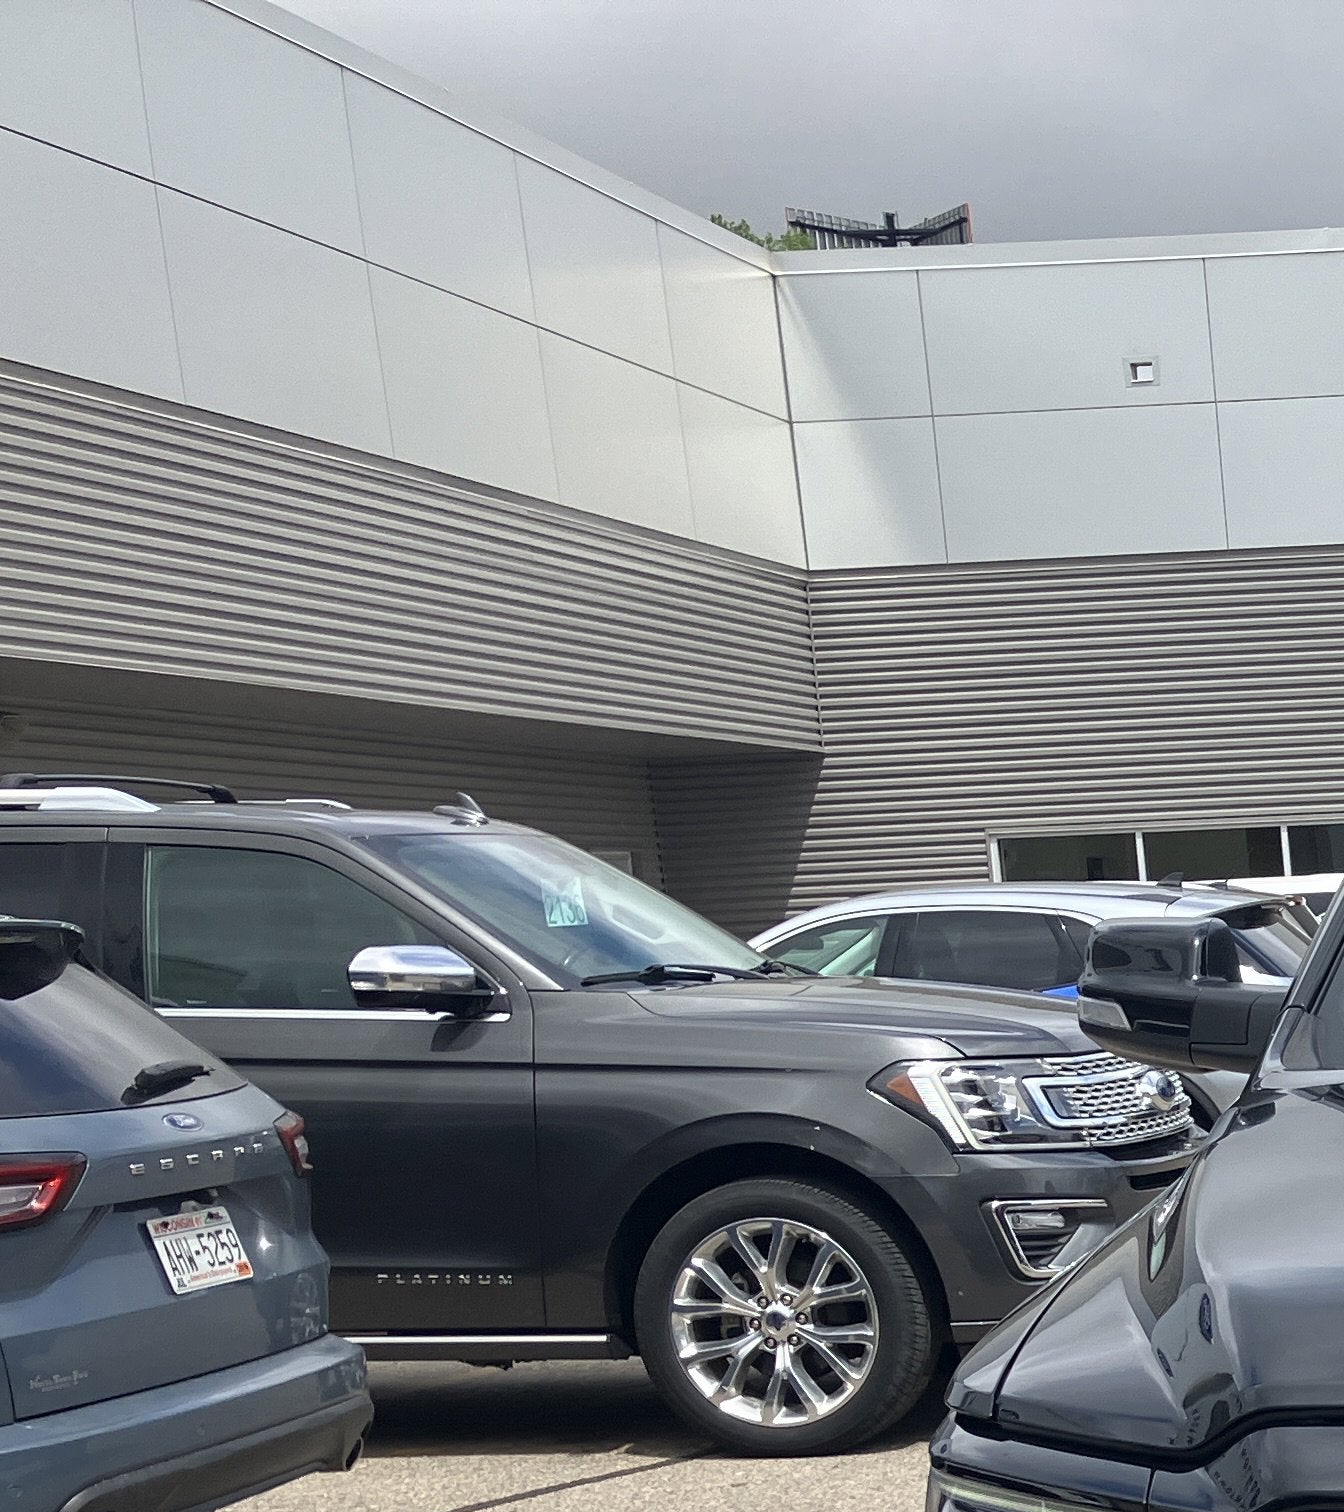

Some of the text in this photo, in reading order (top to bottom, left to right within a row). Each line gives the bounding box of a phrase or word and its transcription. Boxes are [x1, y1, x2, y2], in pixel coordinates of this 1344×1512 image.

[129, 1142, 264, 1175] ESCAPE
[163, 1227, 242, 1278] AHW-5259
[376, 1273, 513, 1285] PLATINUM
